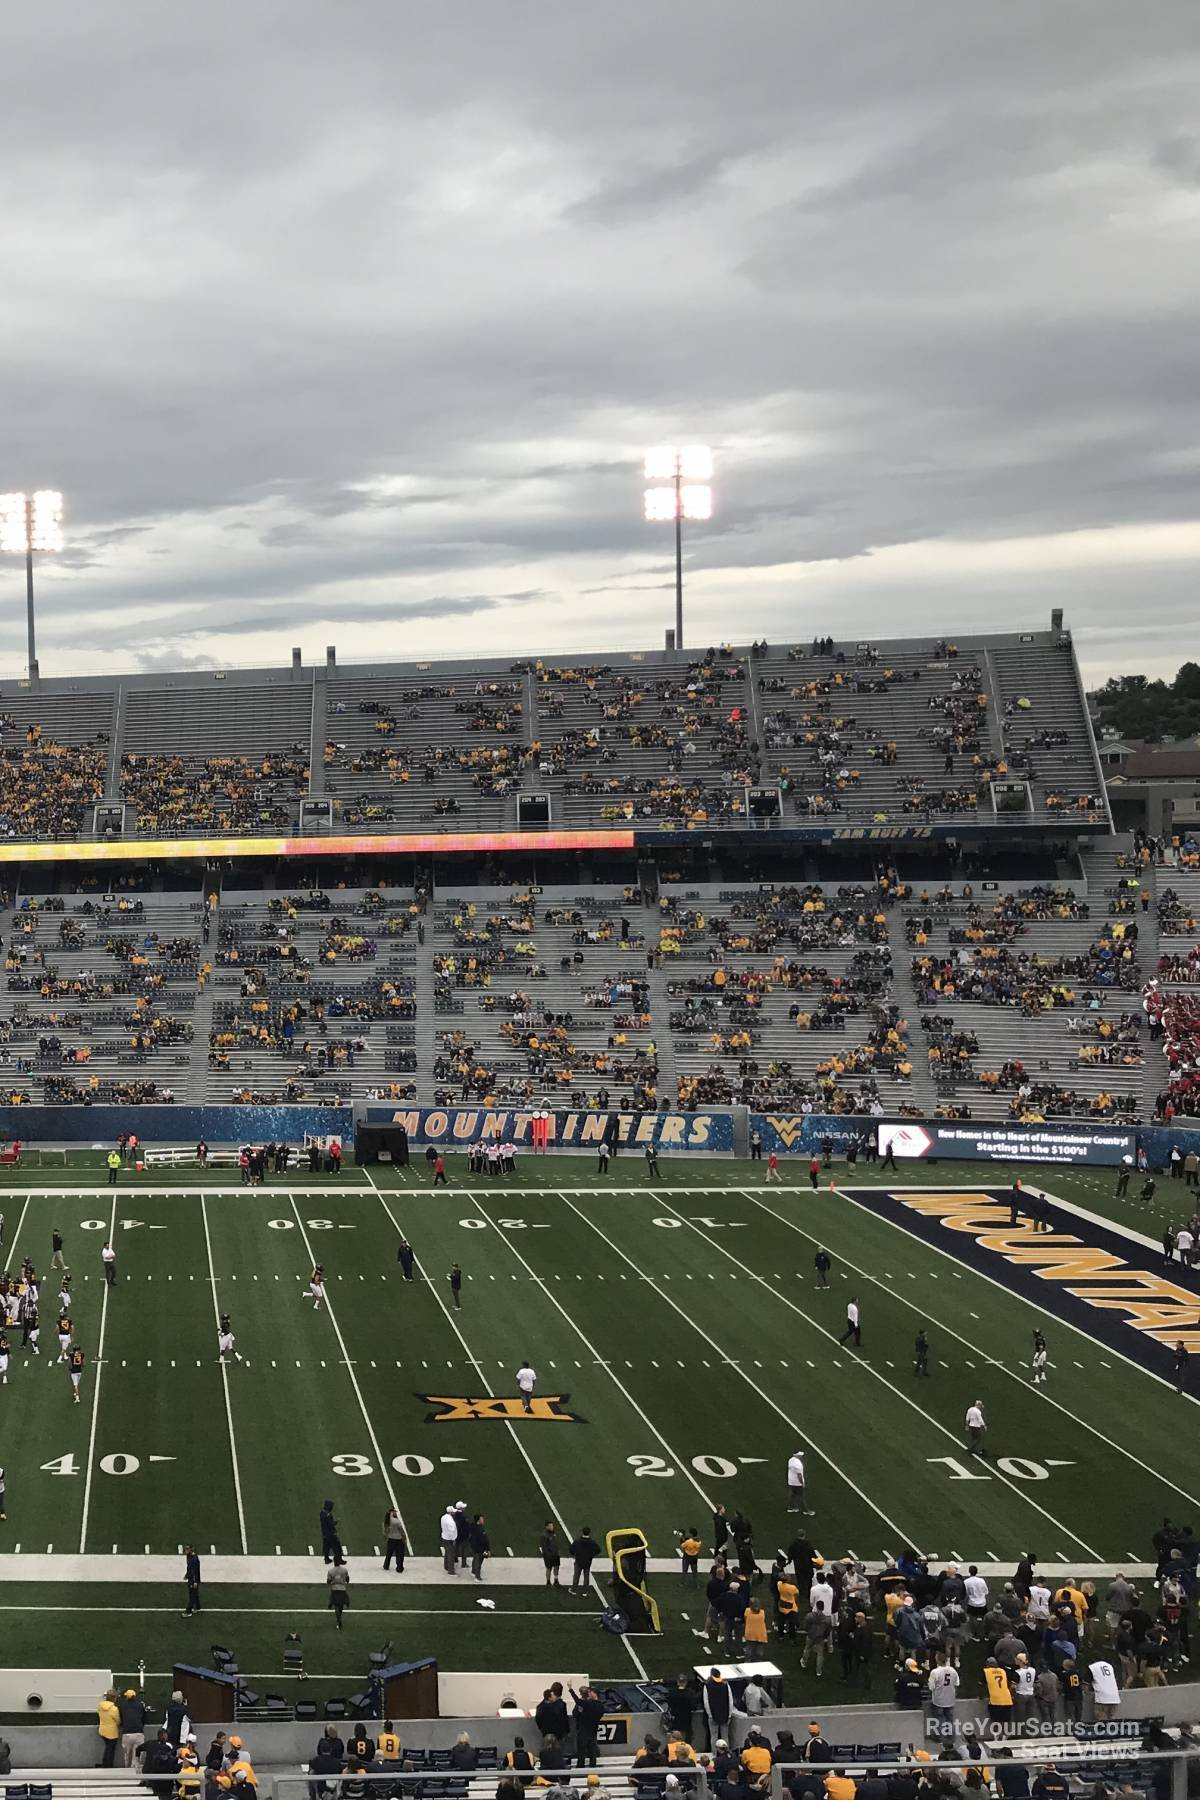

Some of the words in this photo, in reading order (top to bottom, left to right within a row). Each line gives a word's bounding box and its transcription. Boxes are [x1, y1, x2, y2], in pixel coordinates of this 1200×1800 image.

[833, 828, 865, 838] SAM
[869, 828, 909, 838] HUFF
[912, 828, 933, 838] 75
[813, 1130, 859, 1140] NISSAN
[938, 1130, 955, 1138] New
[956, 1130, 982, 1140] Homes
[984, 1131, 992, 1140] in
[993, 1132, 1006, 1140] the
[1007, 1132, 1030, 1142] Heart
[1031, 1133, 1040, 1142] of
[1041, 1134, 1092, 1144] Mountaineer
[1093, 1136, 1129, 1147] Country!
[976, 1142, 1018, 1154] Starting
[1020, 1144, 1030, 1152] in
[1031, 1144, 1050, 1154] the
[81, 1219, 151, 1230] 40
[267, 1218, 335, 1230] 30
[458, 1218, 538, 1230] 20
[425, 1396, 578, 1421] XII
[39, 1453, 141, 1476] 40
[331, 1454, 435, 1477] 30
[626, 1454, 739, 1478] 20
[926, 1456, 1050, 1480] 10
[1100, 1665, 1111, 1677] 16
[943, 1673, 951, 1686] 5
[994, 1675, 1003, 1688] 7
[1025, 1672, 1032, 1684] 8
[1069, 1674, 1080, 1687] 18
[357, 1740, 366, 1755] 8
[386, 1738, 394, 1752] 8
